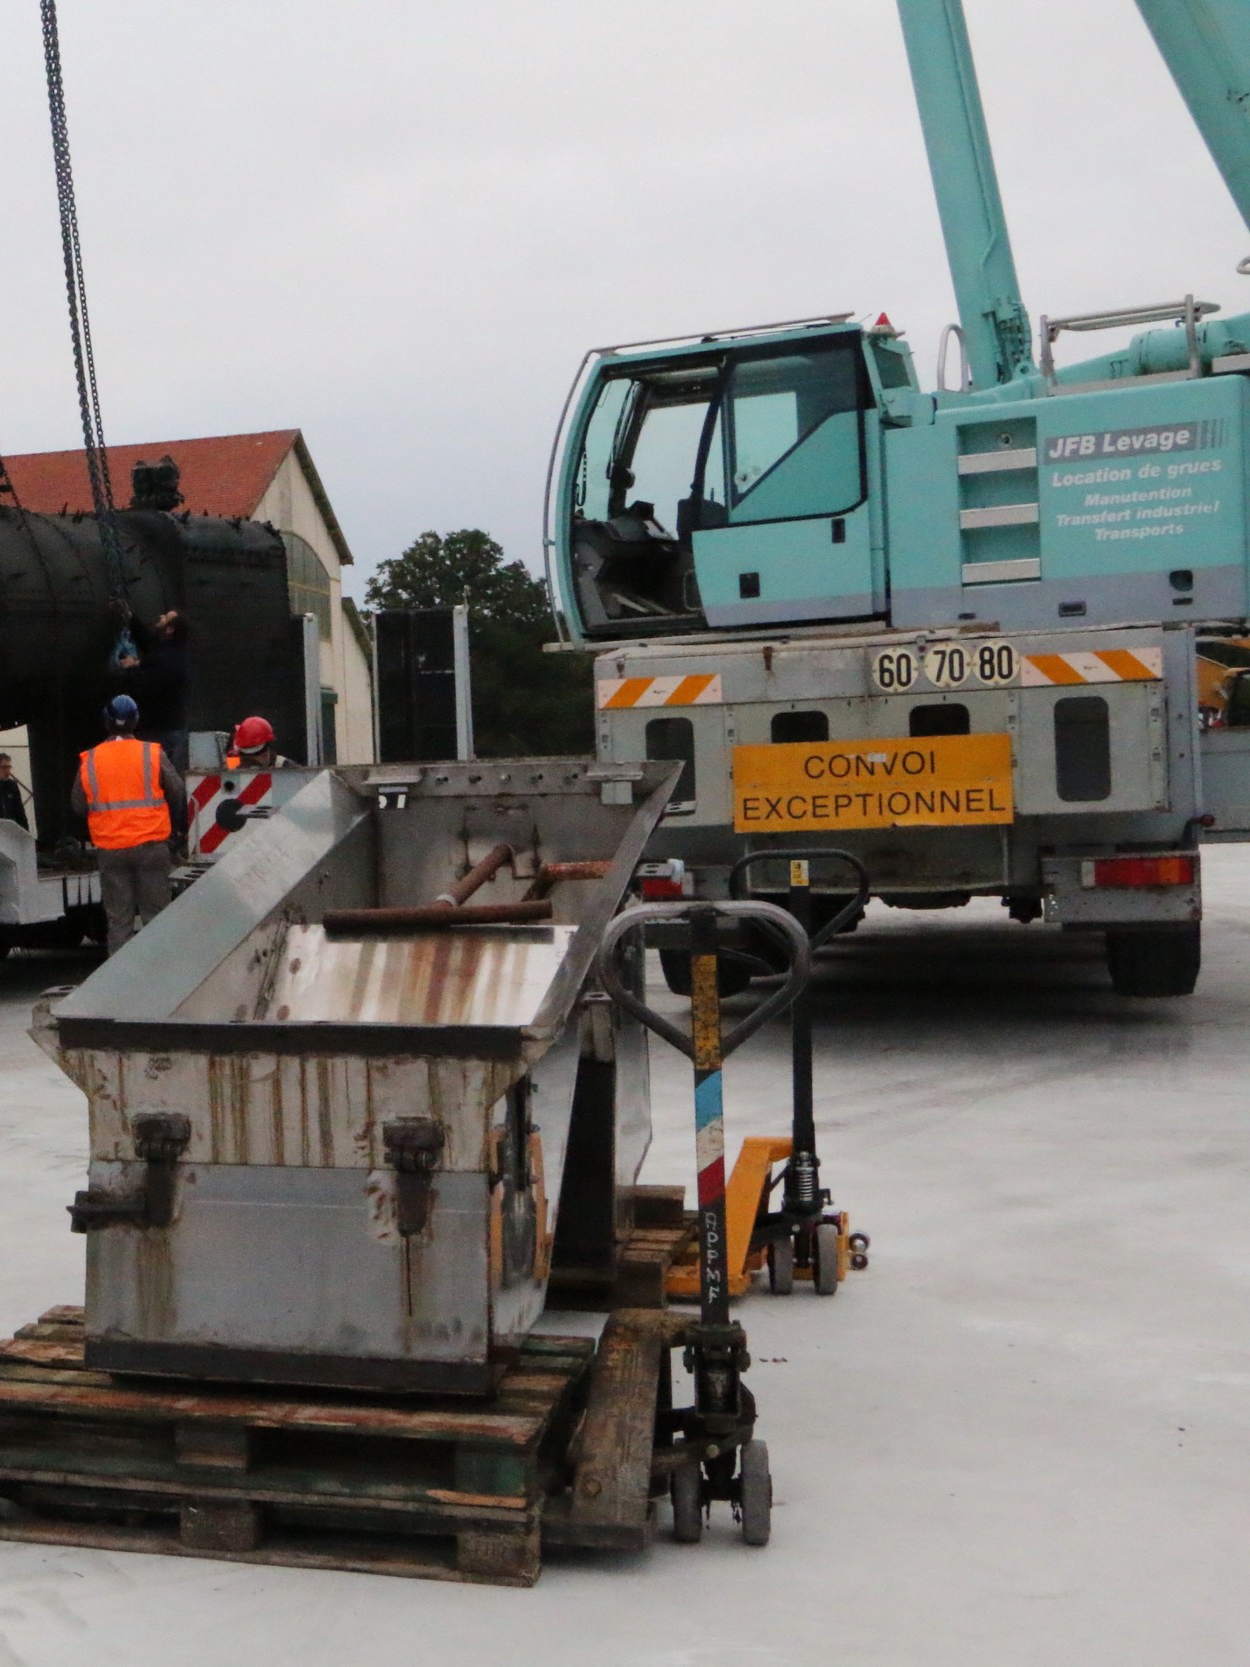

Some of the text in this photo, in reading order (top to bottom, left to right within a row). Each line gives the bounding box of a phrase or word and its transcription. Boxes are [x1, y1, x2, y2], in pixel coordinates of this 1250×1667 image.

[1049, 429, 1190, 458] JFB Levage
[1052, 459, 1221, 487] Location de grues
[1084, 487, 1192, 507] Manutention
[1056, 501, 1220, 526] Transfert industriel
[1095, 523, 1184, 540] Transports
[879, 645, 1013, 688] 60 70 80
[804, 751, 936, 779] CONVOI
[743, 788, 1006, 821] EXCEPTIONNEL
